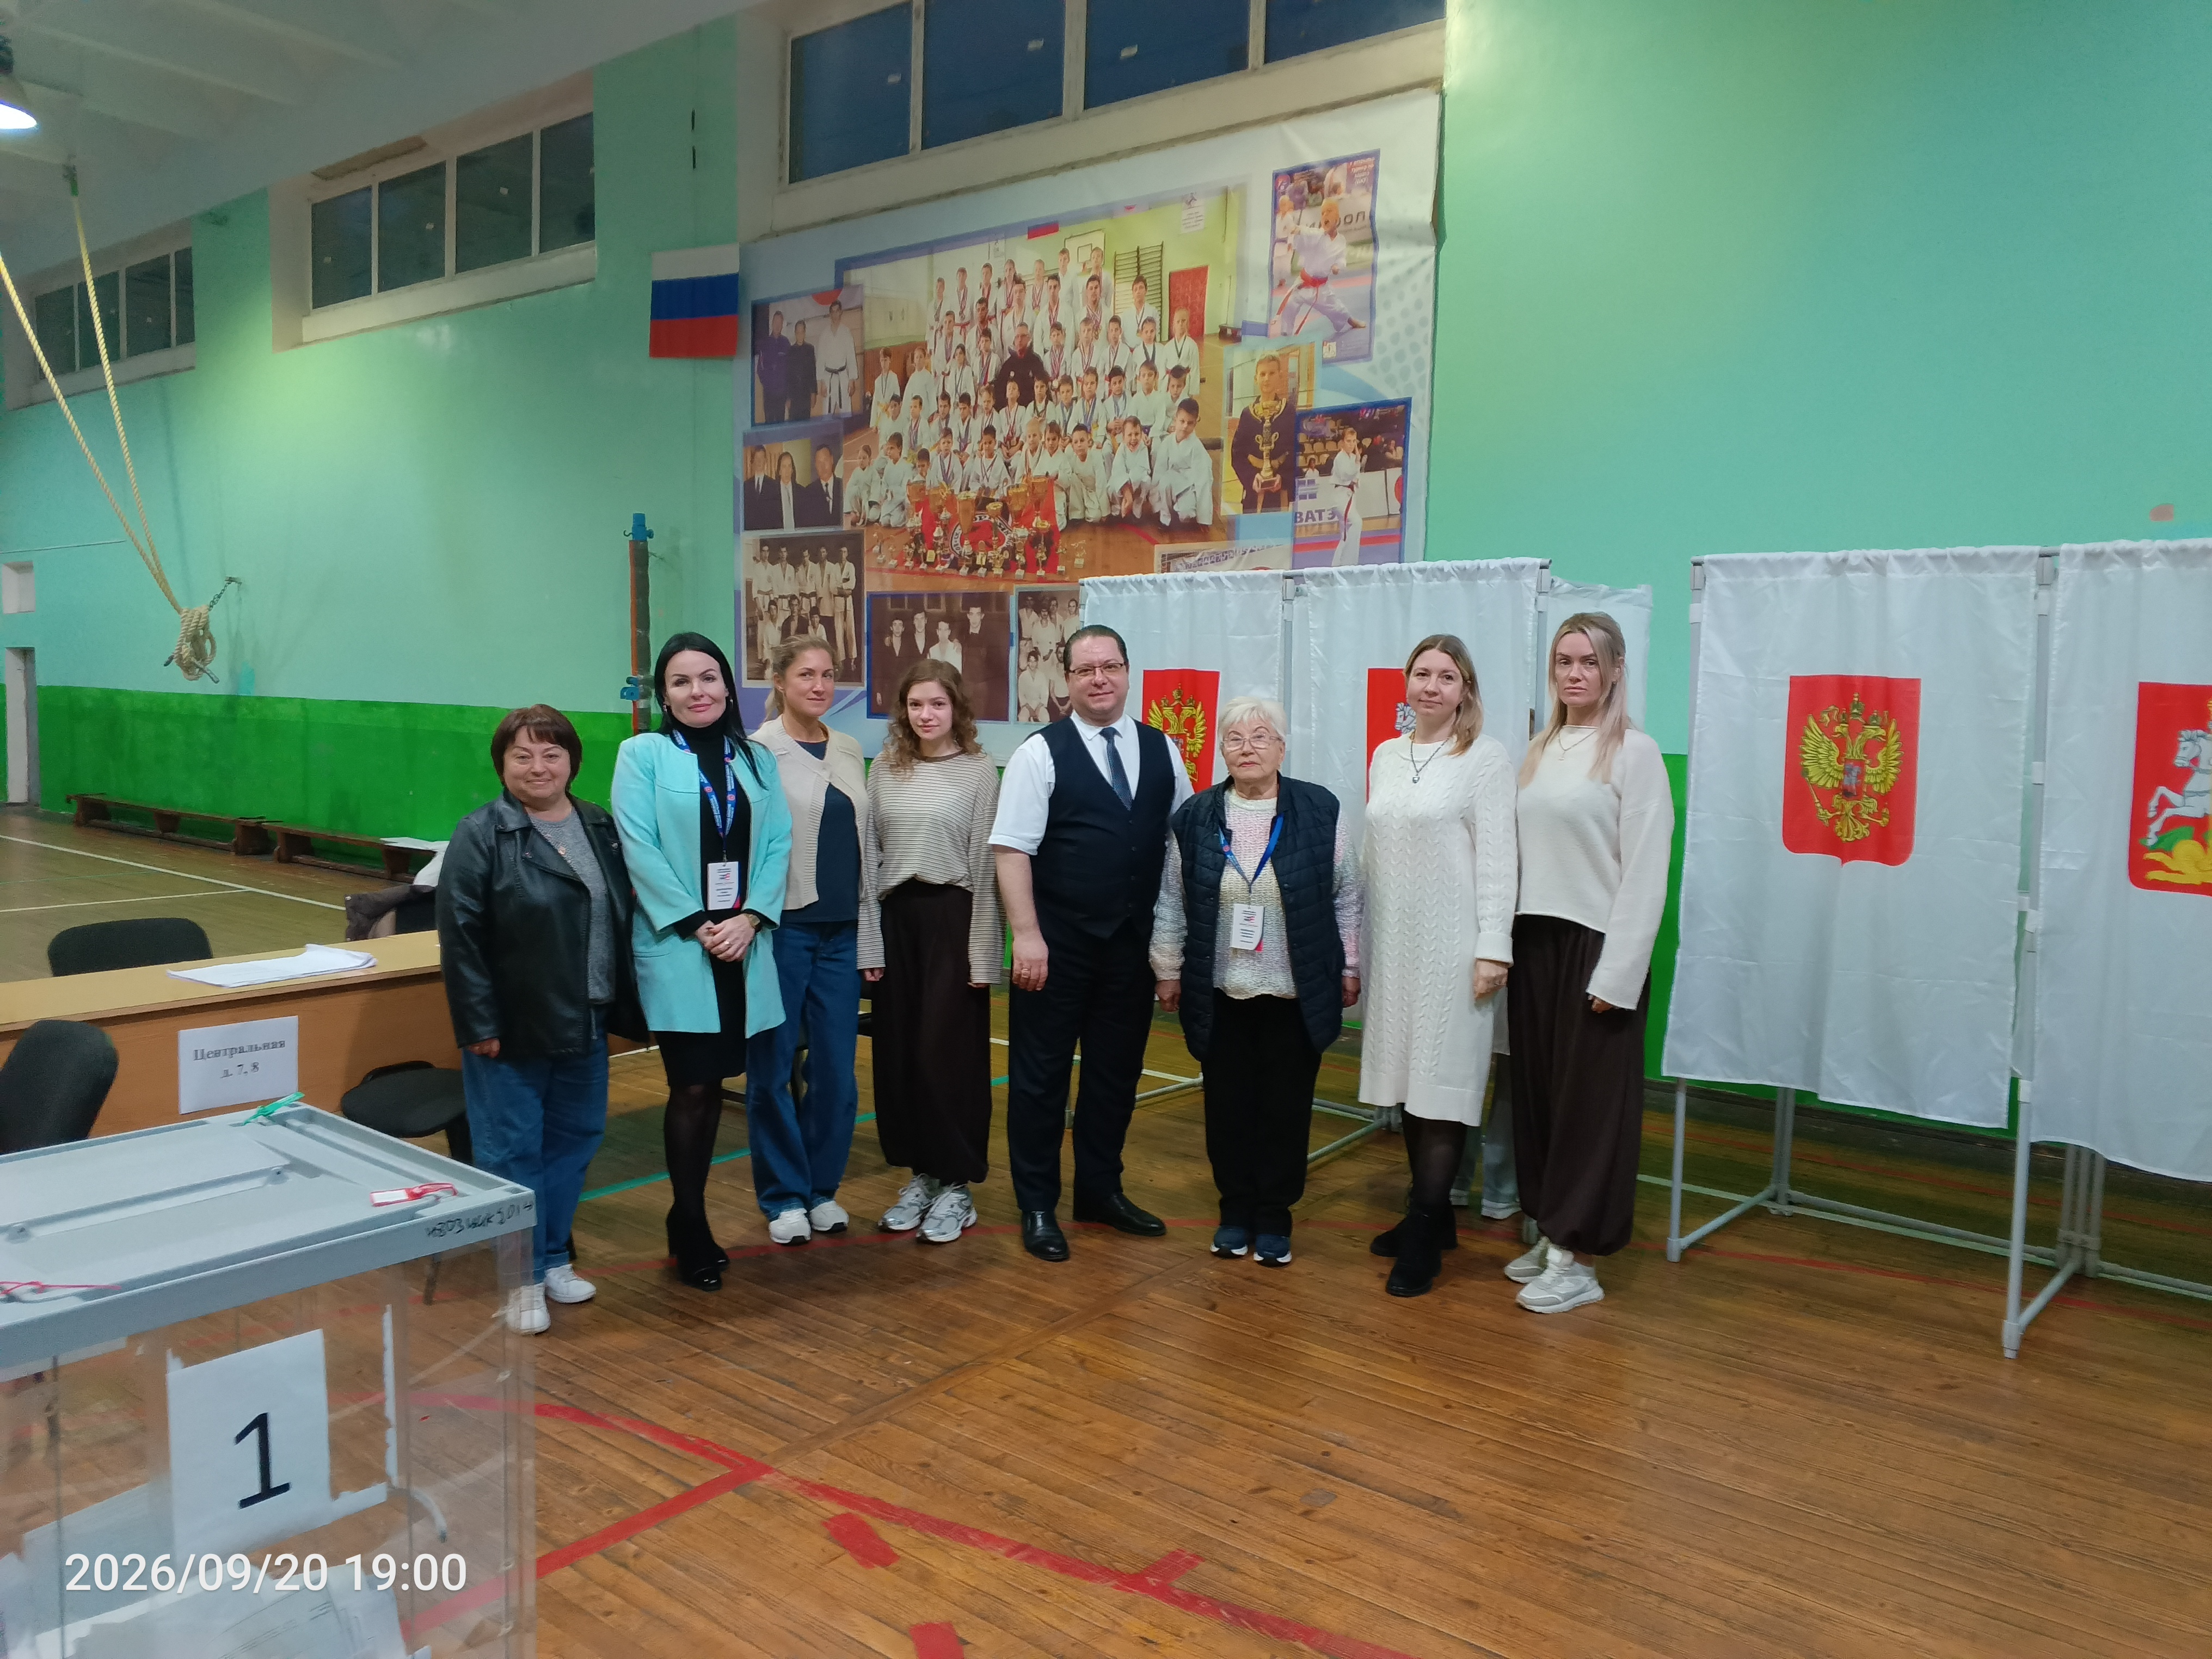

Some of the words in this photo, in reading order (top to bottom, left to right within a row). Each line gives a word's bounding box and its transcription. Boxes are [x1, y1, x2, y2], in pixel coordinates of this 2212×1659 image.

[193, 1040, 286, 1061] Центральная
[237, 1064, 248, 1076] 7,
[251, 1061, 260, 1073] 8
[235, 1412, 291, 1509] 1
